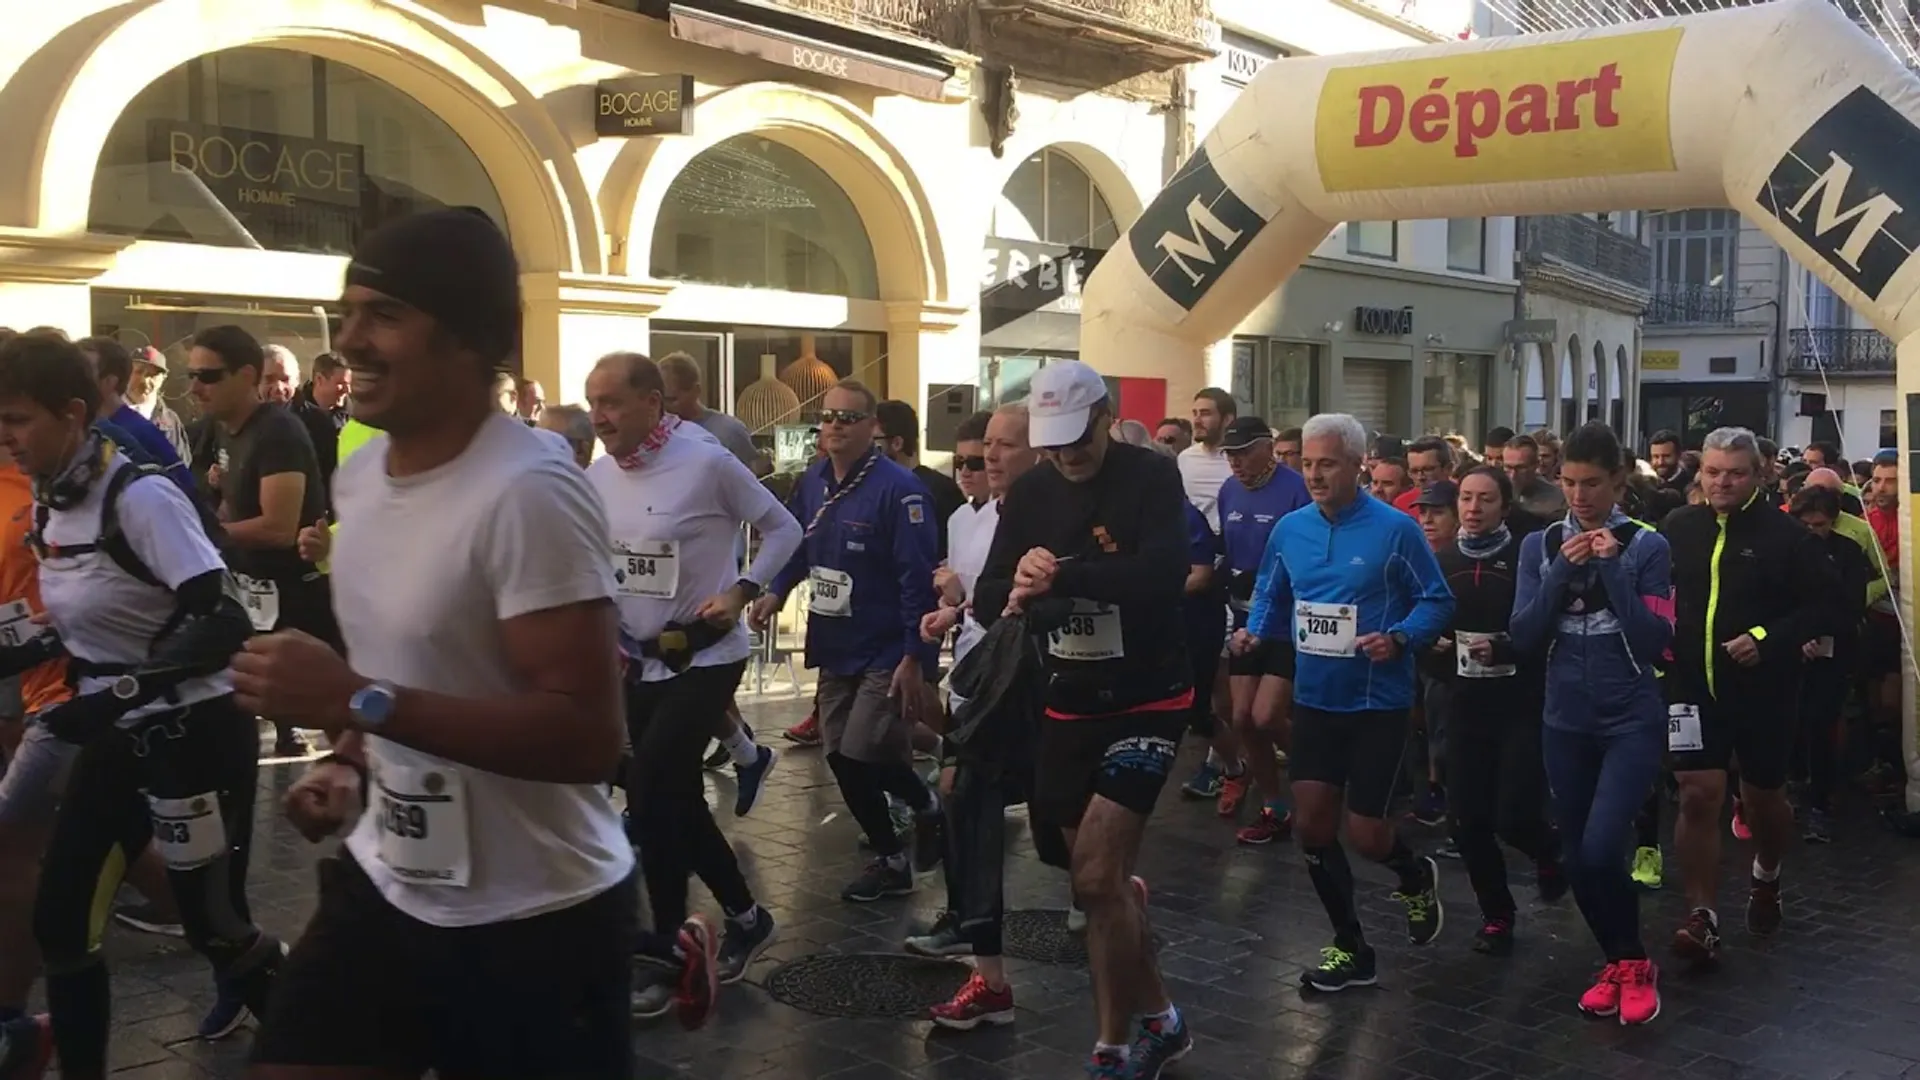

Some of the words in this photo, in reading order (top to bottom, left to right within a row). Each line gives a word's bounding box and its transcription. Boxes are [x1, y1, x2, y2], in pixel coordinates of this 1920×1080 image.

[793, 46, 848, 78] BOCAGE
[1228, 49, 1264, 76] KOO
[600, 90, 678, 116] BOCAGE
[1354, 62, 1622, 158] Départ
[623, 116, 653, 128] HOMME
[170, 131, 355, 193] BOCAGE
[238, 188, 296, 208] HOMME
[1785, 150, 1904, 274] M
[1155, 194, 1244, 287] M
[628, 558, 656, 576] 584
[1307, 619, 1339, 636] 1204
